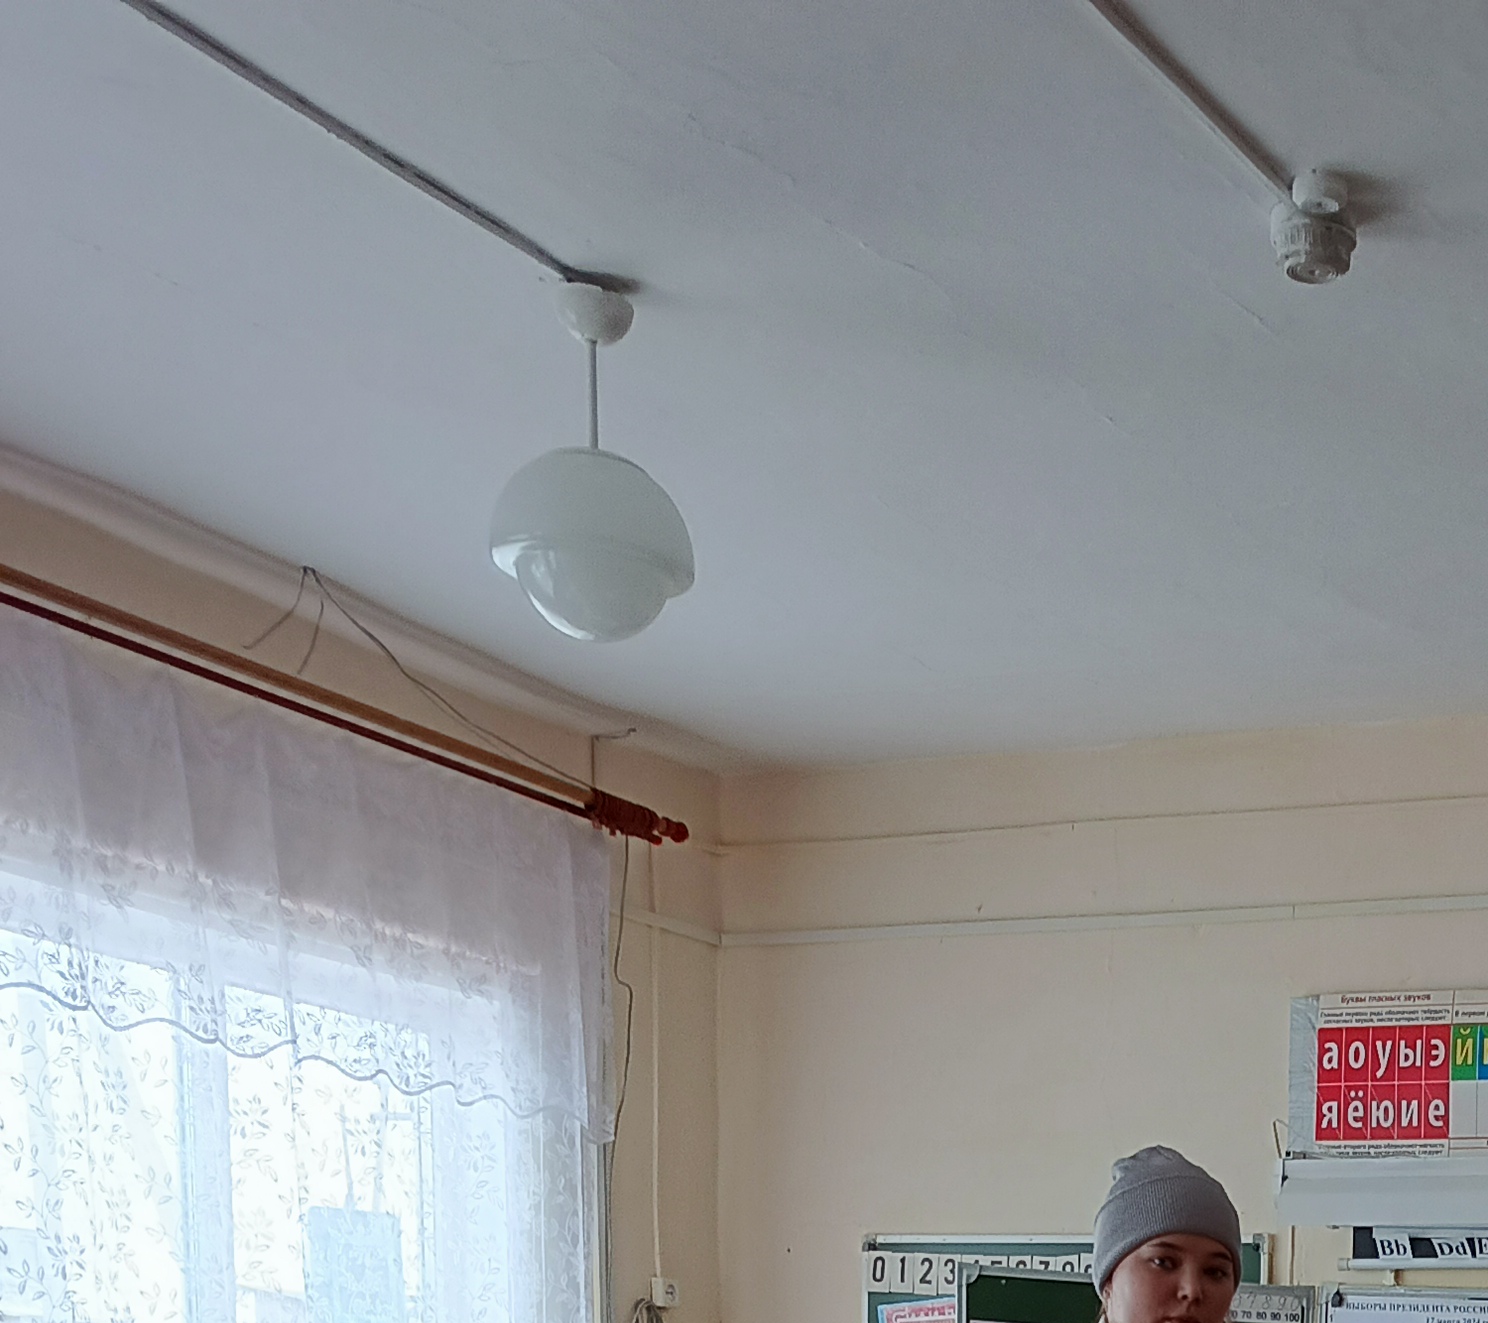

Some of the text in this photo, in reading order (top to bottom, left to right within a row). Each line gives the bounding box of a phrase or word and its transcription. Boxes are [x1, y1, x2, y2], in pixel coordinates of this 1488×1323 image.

[1322, 1042, 1339, 1070] а
[1349, 1040, 1365, 1068] о
[1376, 1040, 1392, 1078] у
[1400, 1040, 1421, 1067] ы
[1429, 1040, 1445, 1067] э
[1456, 1027, 1473, 1065] й
[1322, 1101, 1338, 1129] я
[1349, 1090, 1364, 1127] ё
[1372, 1101, 1394, 1127] ю
[1402, 1100, 1418, 1127] и
[1428, 1099, 1445, 1126] е
[1380, 1239, 1406, 1256] Bb
[872, 1257, 885, 1283] 0
[900, 1257, 906, 1283] 1
[919, 1258, 933, 1284] 2
[944, 1259, 955, 1285] 3
[1242, 1311, 1299, 1322] 70 80 90 100
[1346, 1302, 1386, 1311] ВЫБОРЫ
[1390, 1303, 1450, 1313] ПРЕЗИДЕНТА
